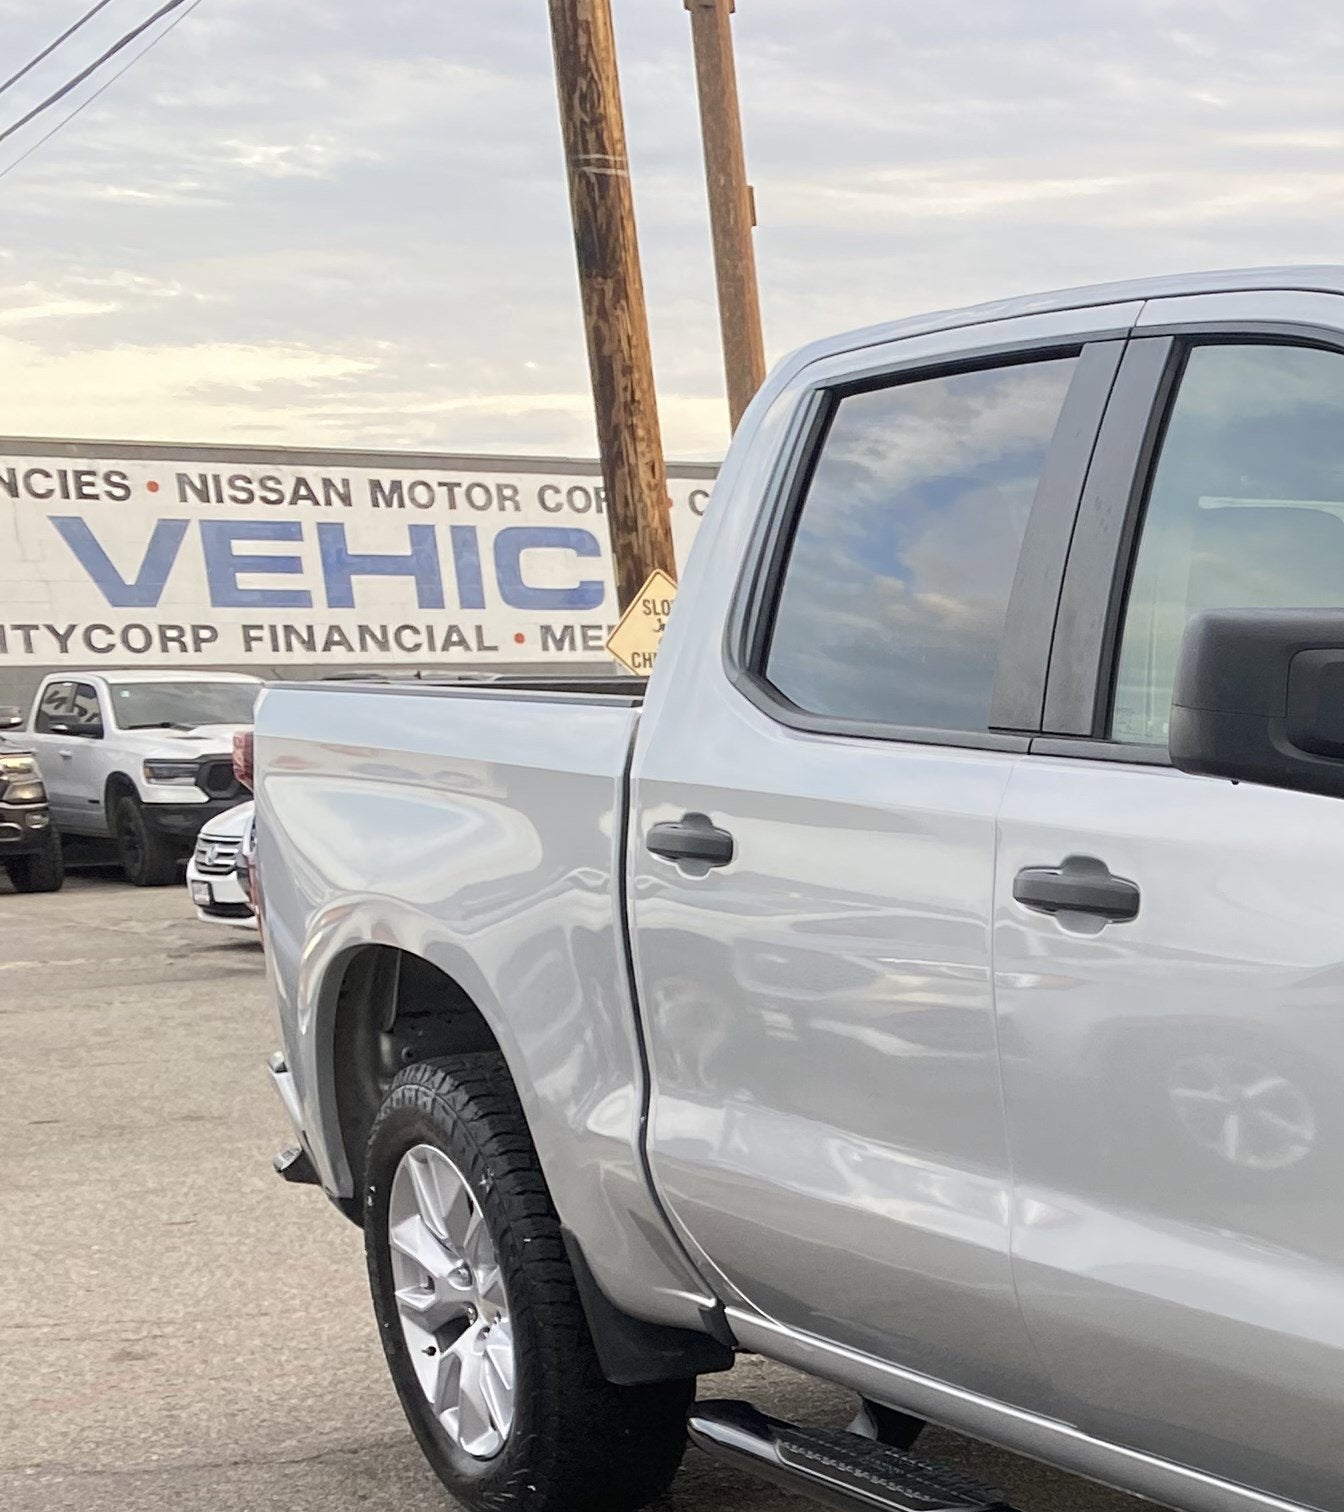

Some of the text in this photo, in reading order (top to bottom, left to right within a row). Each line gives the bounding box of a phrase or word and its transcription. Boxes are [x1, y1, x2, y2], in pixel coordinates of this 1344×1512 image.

[176, 473, 353, 508] NISSAN
[368, 479, 522, 512] MOTOR
[47, 515, 606, 611] VEHIC
[642, 599, 675, 617] SLO
[242, 623, 499, 653] FINANCIAL
[540, 624, 616, 653] ME
